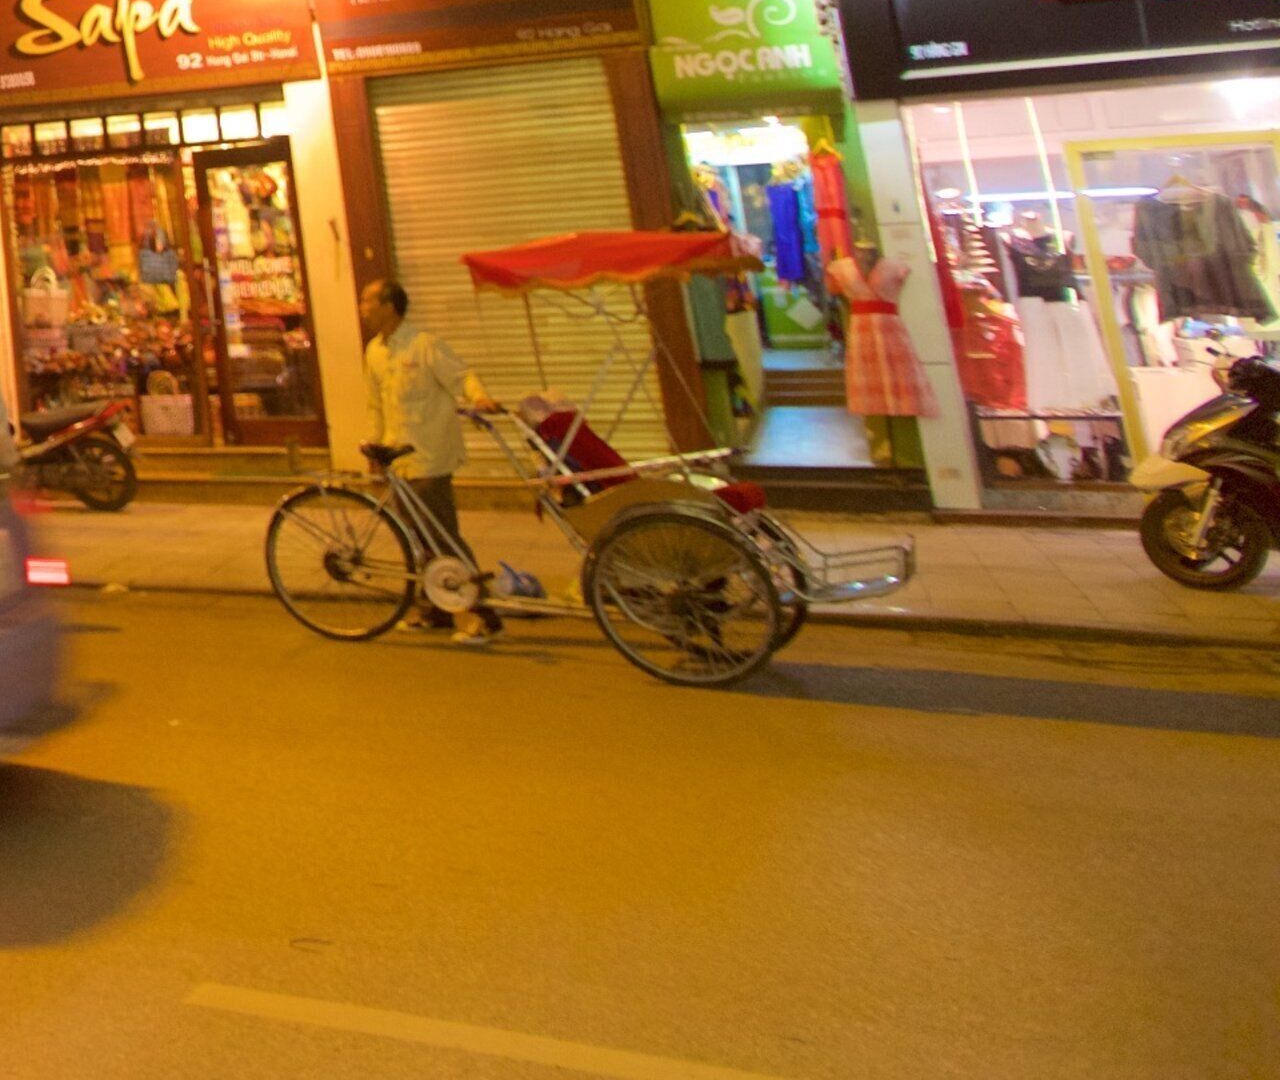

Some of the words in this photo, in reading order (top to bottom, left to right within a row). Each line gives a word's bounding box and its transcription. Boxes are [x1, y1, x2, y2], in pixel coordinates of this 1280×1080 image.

[207, 33, 241, 52] High
[241, 28, 292, 47] Quality
[176, 51, 203, 70] 92
[673, 48, 755, 81] NGỌC
[756, 43, 813, 70] ANH
